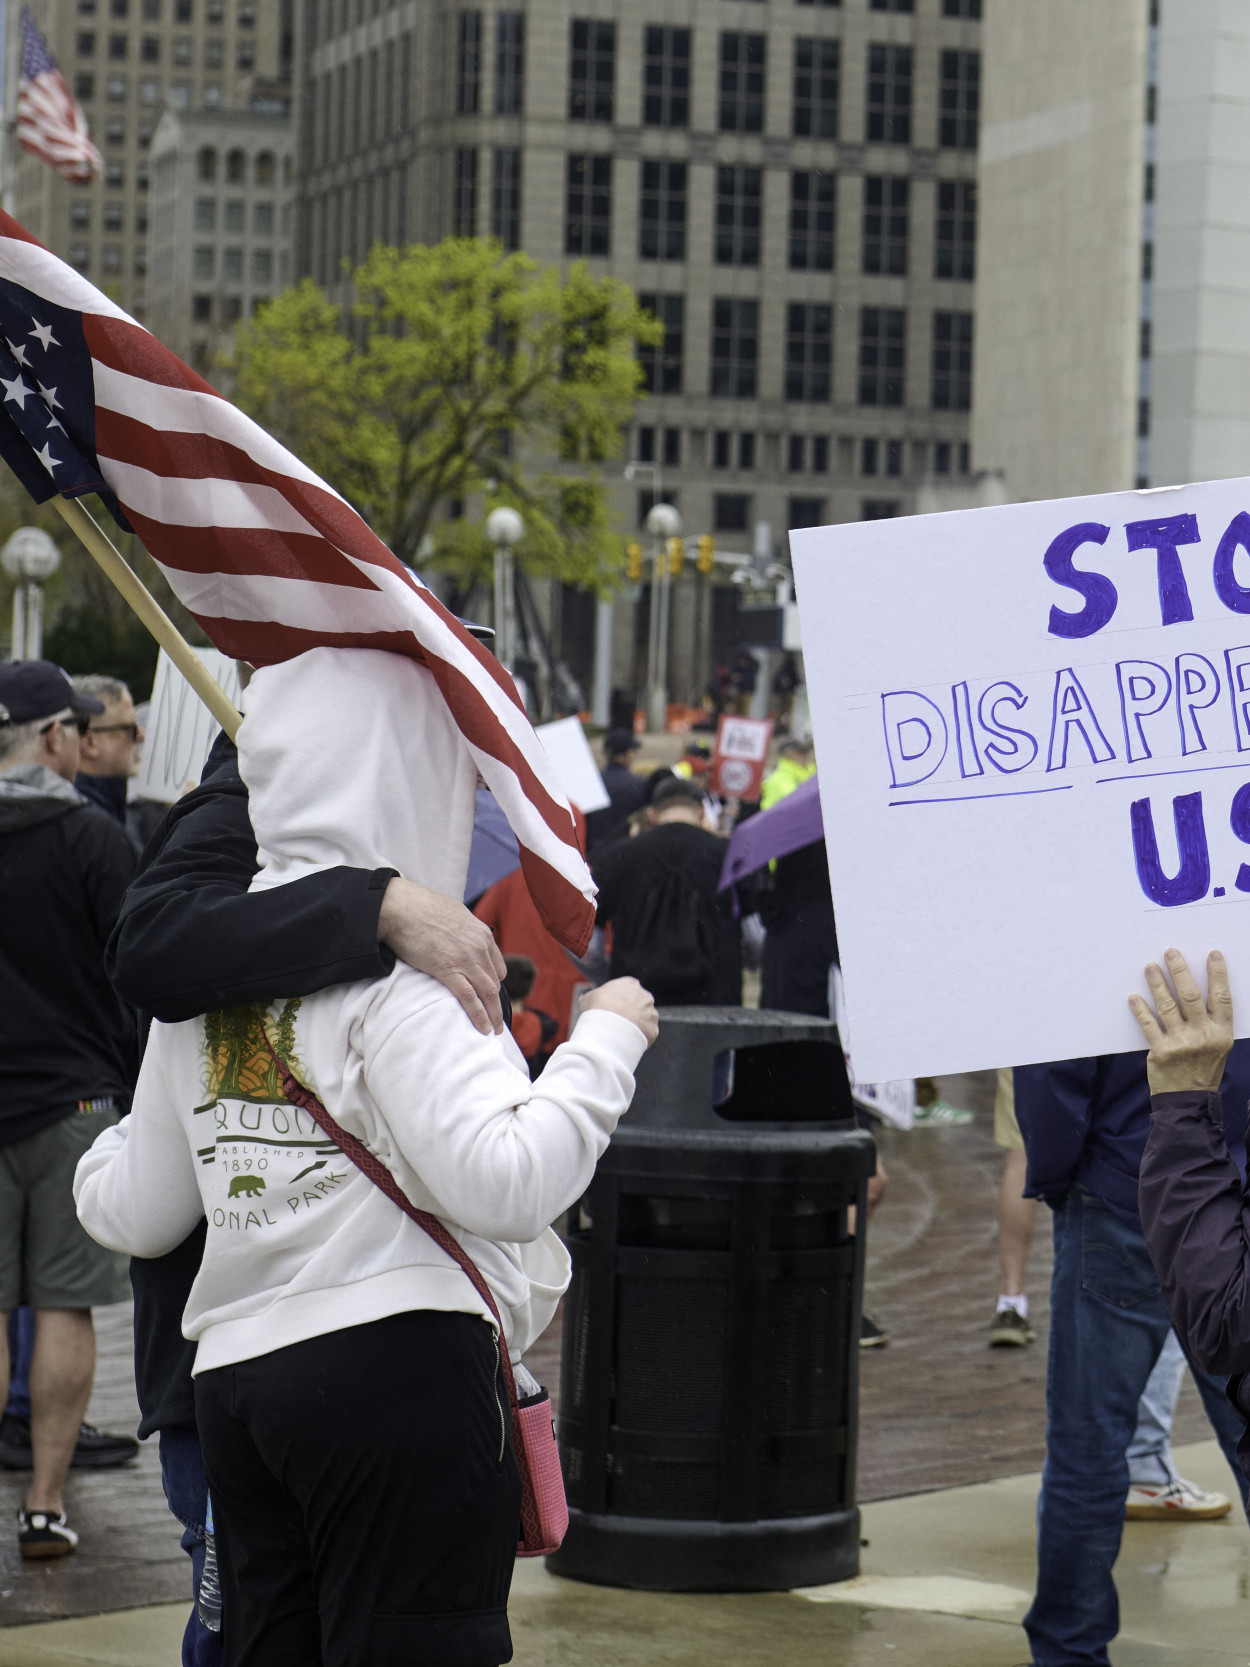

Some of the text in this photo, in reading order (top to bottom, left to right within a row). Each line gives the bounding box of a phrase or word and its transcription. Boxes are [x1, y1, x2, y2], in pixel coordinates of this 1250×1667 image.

[213, 1101, 320, 1135] QUOI
[221, 1157, 269, 1173] 1890
[209, 1171, 348, 1231] ONAL PARK
